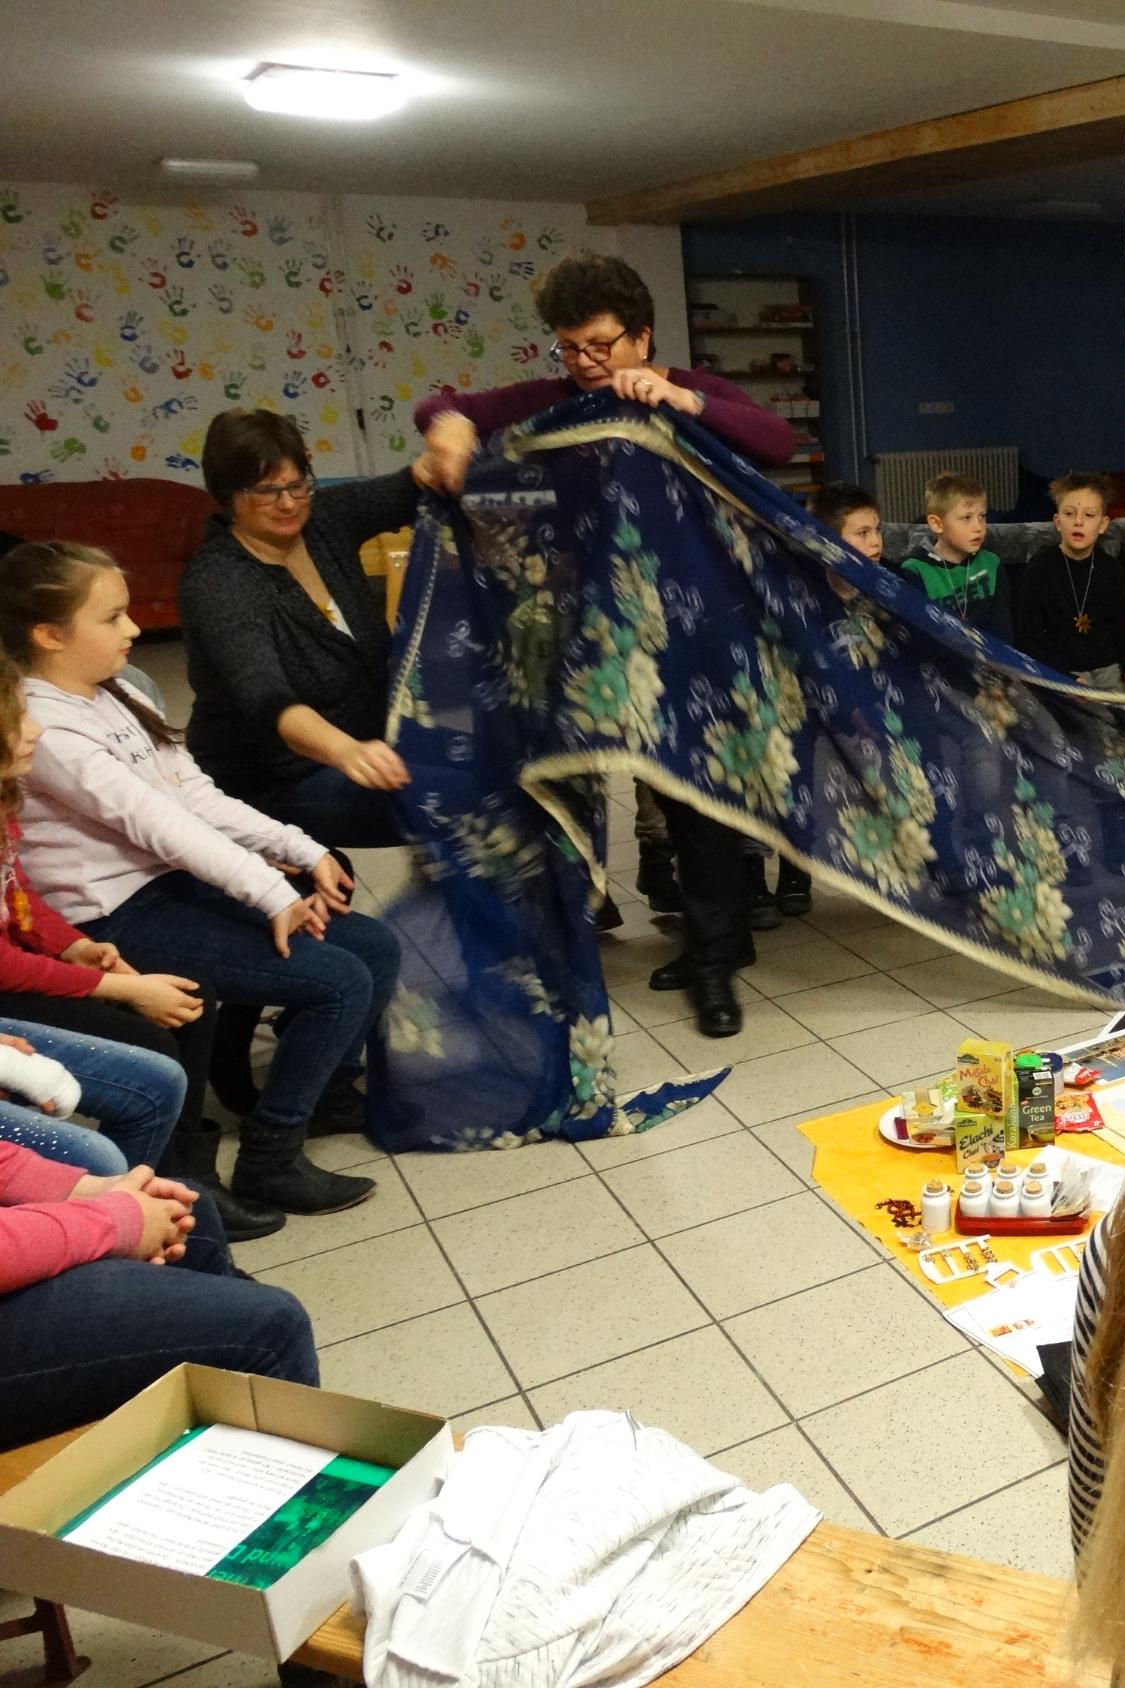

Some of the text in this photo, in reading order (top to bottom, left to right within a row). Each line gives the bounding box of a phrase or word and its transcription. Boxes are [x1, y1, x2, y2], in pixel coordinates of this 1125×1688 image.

[1022, 1104, 1052, 1114] Green
[1029, 1114, 1045, 1122] Tea
[960, 1124, 993, 1150] Elachi
